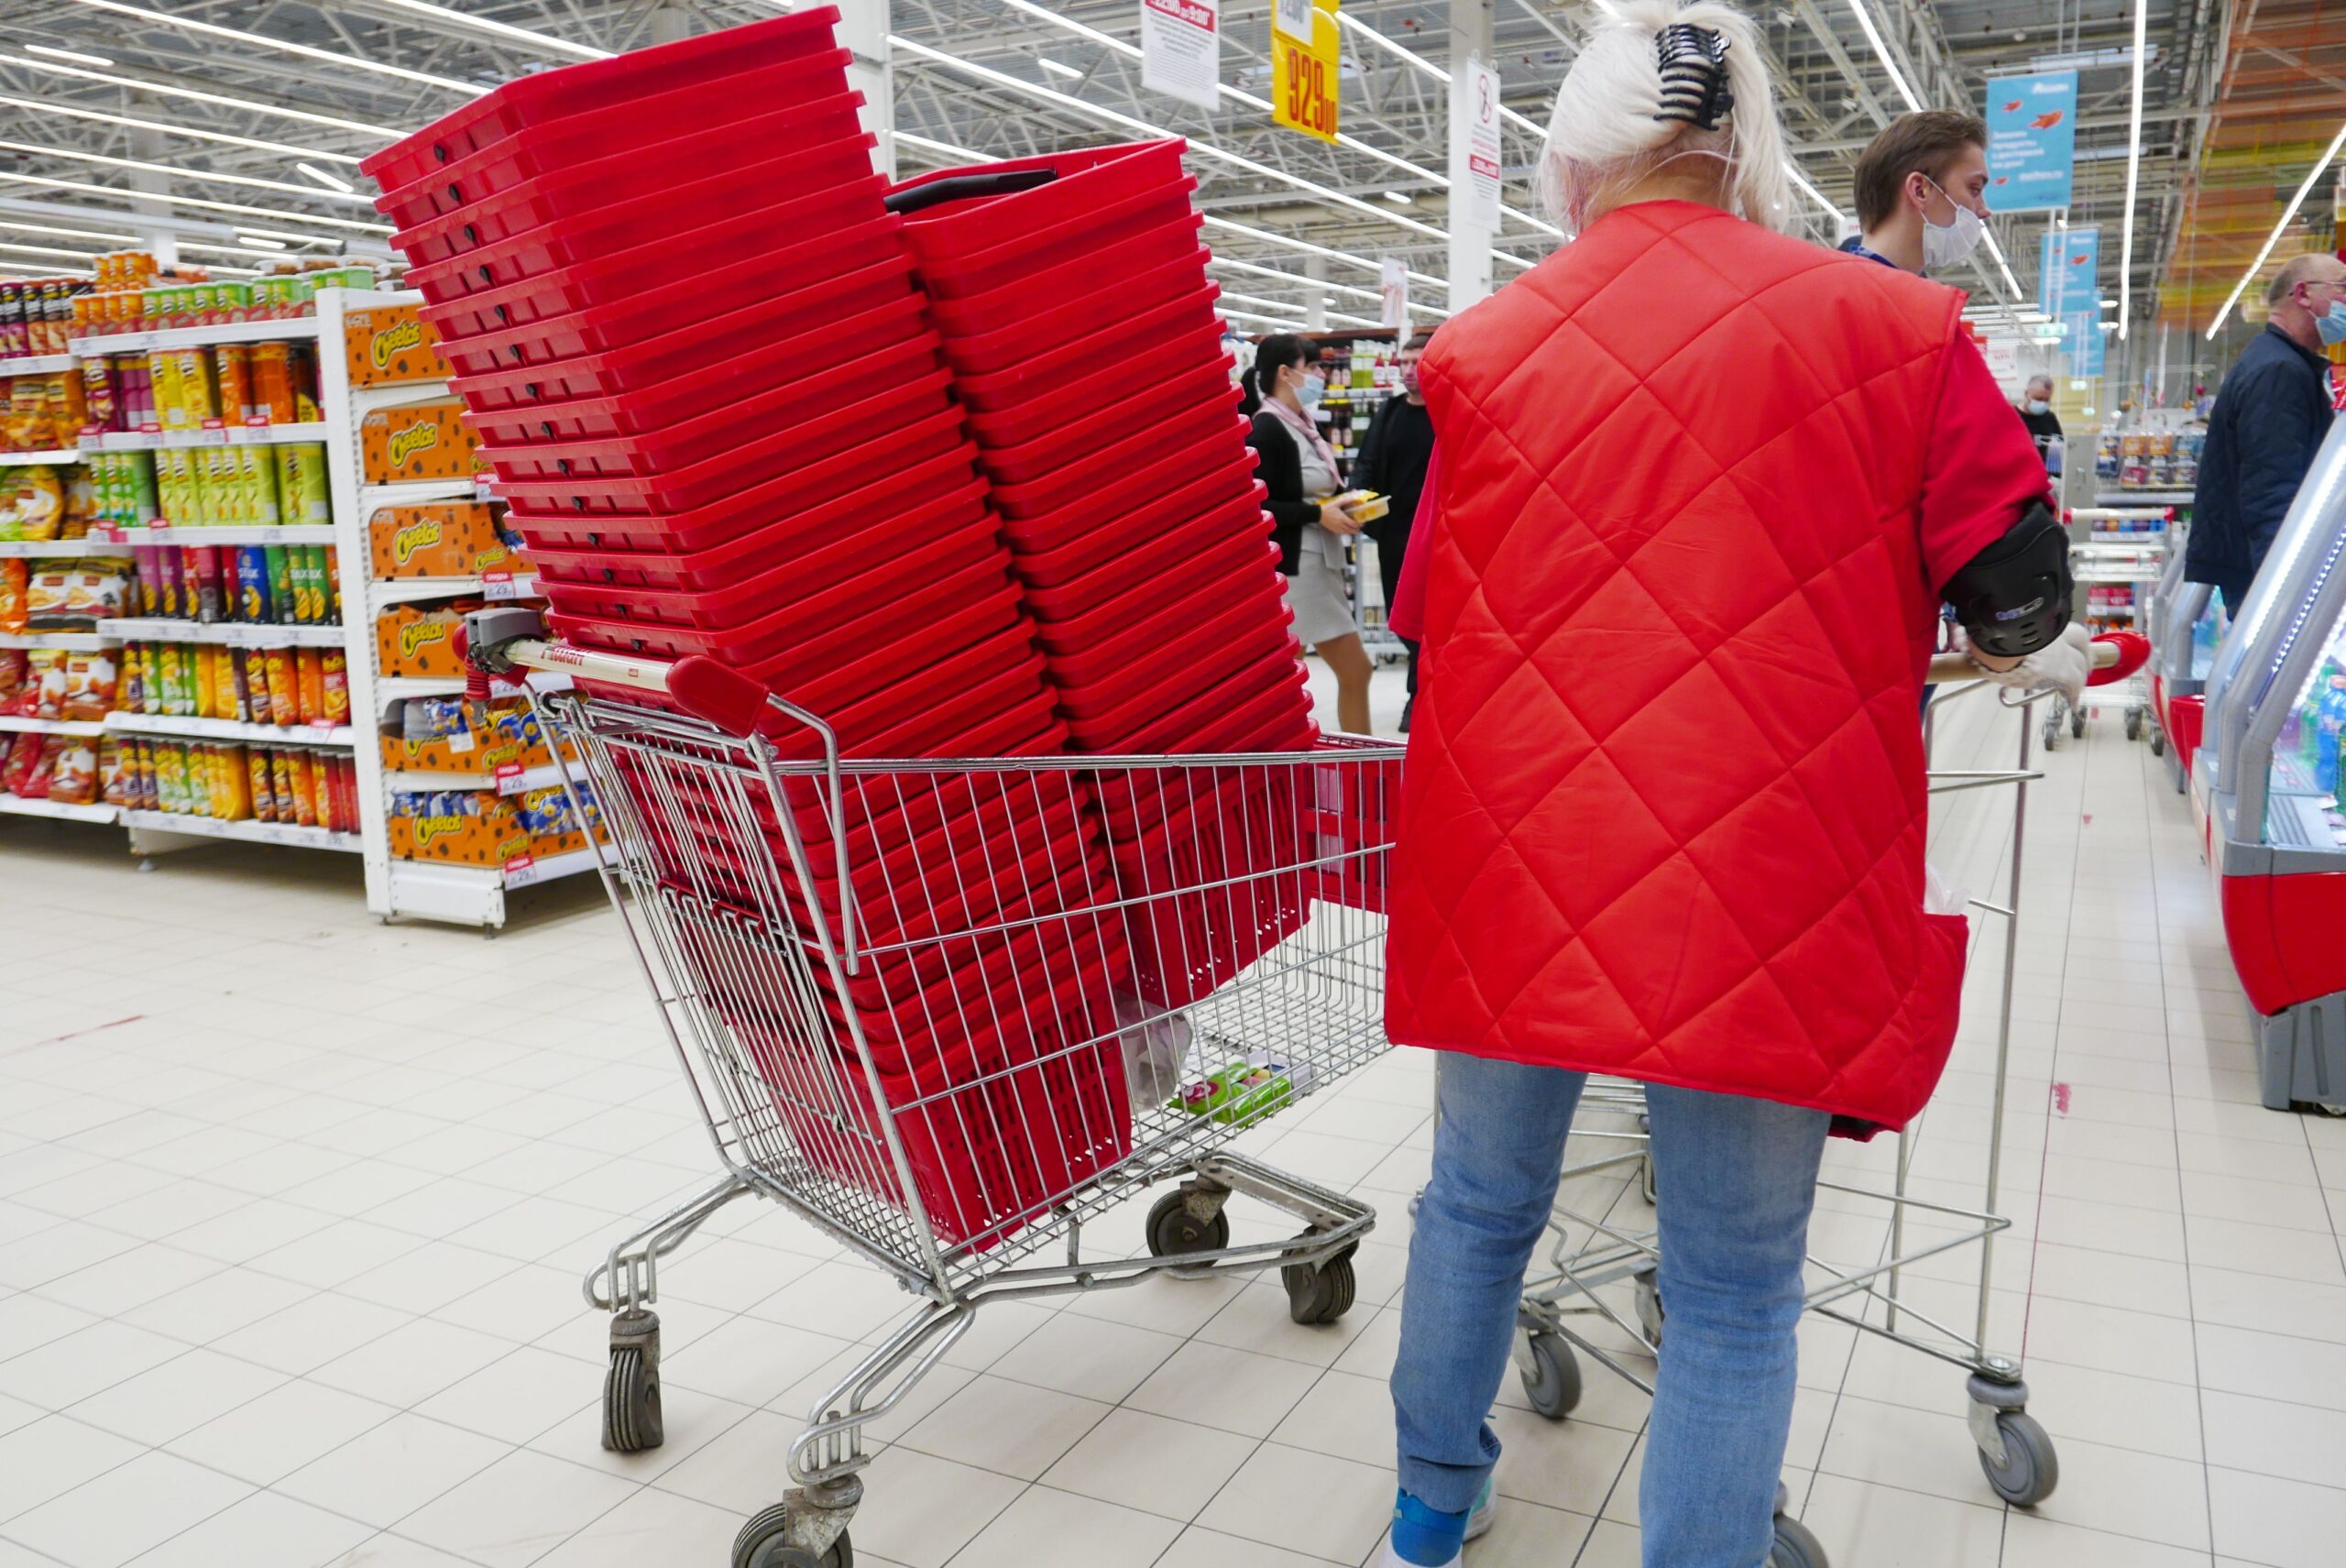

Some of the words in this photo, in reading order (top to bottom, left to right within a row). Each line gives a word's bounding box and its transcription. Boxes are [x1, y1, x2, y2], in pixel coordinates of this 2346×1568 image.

[1288, 47, 1322, 131] 929
[374, 321, 421, 367] Cheetos
[389, 422, 436, 467] Cheetos
[396, 520, 440, 564] Cheetos
[401, 622, 444, 657] Cheetos
[415, 813, 462, 845] Cheetos
